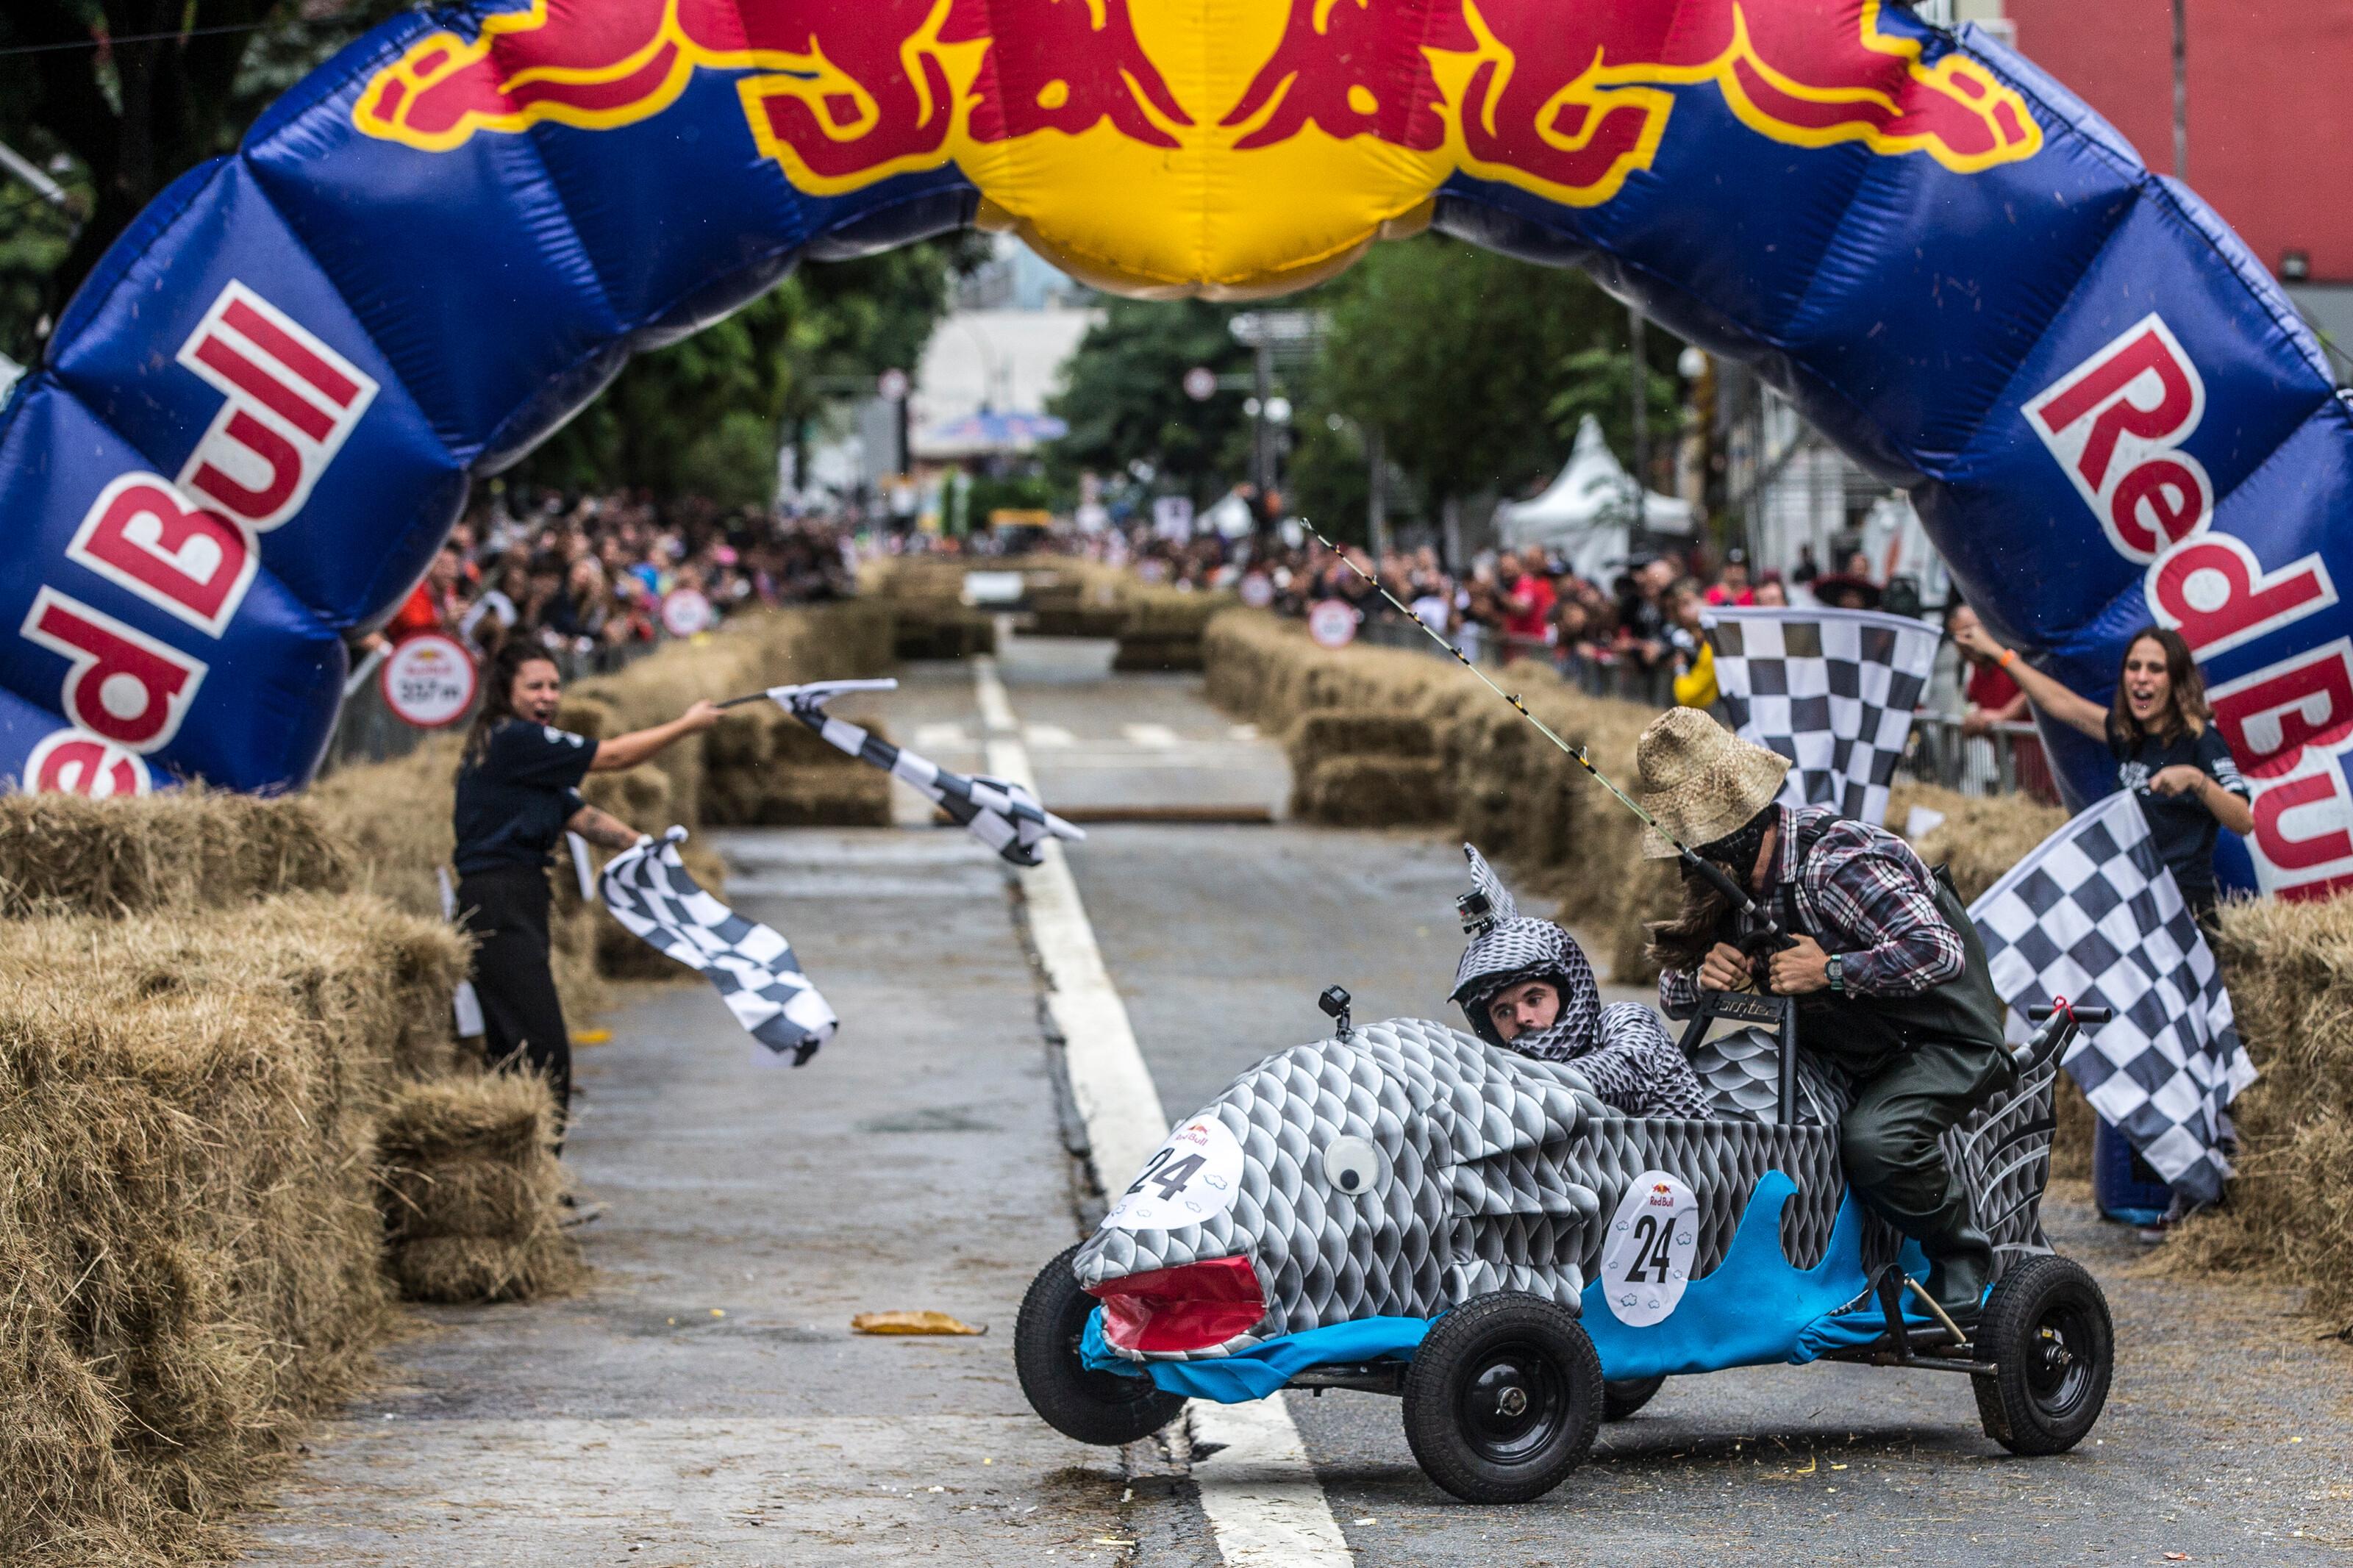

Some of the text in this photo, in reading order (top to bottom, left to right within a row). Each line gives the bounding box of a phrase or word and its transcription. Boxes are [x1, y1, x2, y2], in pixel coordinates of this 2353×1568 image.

[76, 288, 371, 629] Bull
[2030, 321, 2330, 657] Red
[1125, 1148, 1207, 1201] 24
[1188, 1133, 1208, 1147] Bull
[1624, 1214, 1677, 1284] 24
